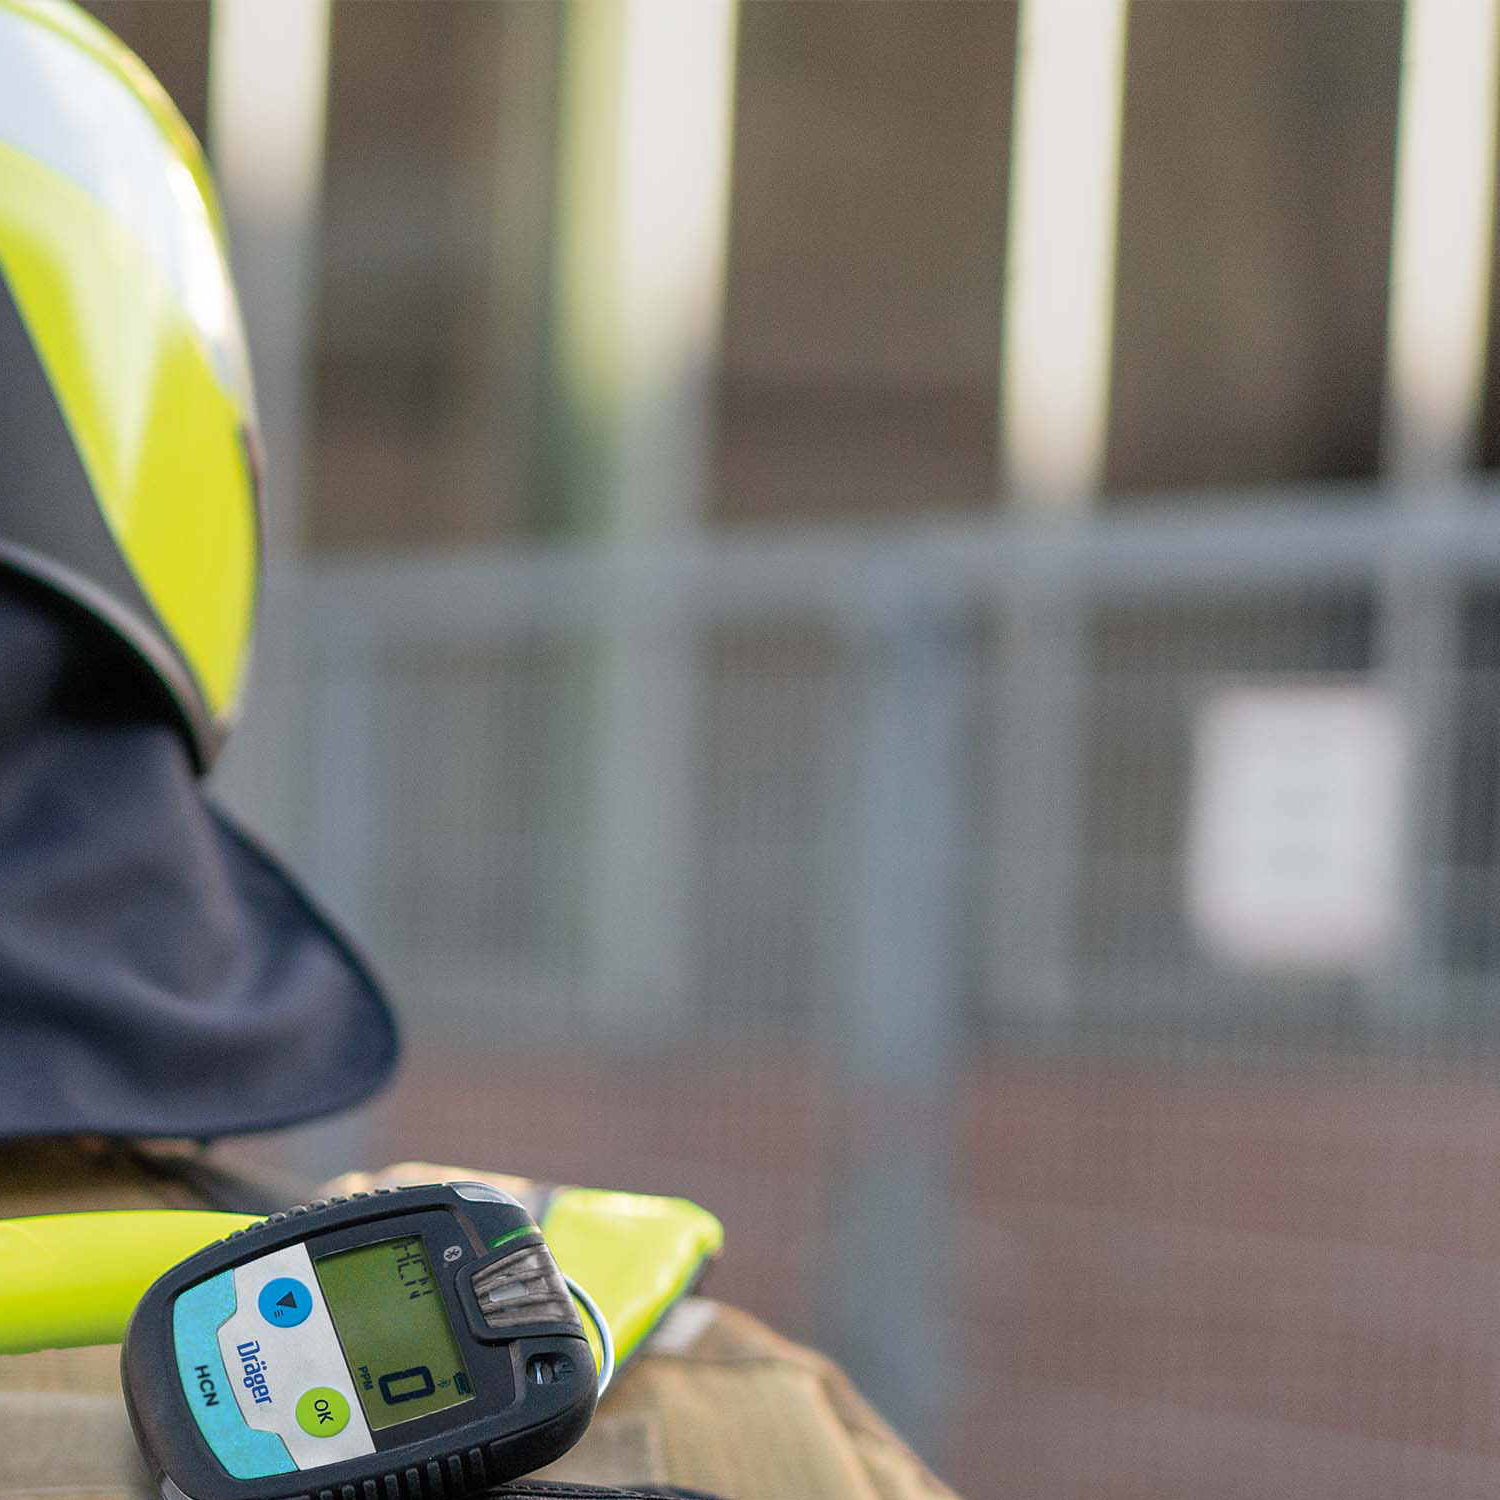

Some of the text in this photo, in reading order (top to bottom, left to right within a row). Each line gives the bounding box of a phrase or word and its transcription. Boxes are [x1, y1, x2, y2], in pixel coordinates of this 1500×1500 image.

[195, 1364, 219, 1407] HCN
[236, 1340, 273, 1404] Dräger
[358, 1365, 373, 1390] PPM
[378, 1365, 435, 1405] 0
[314, 1399, 334, 1424] OK
